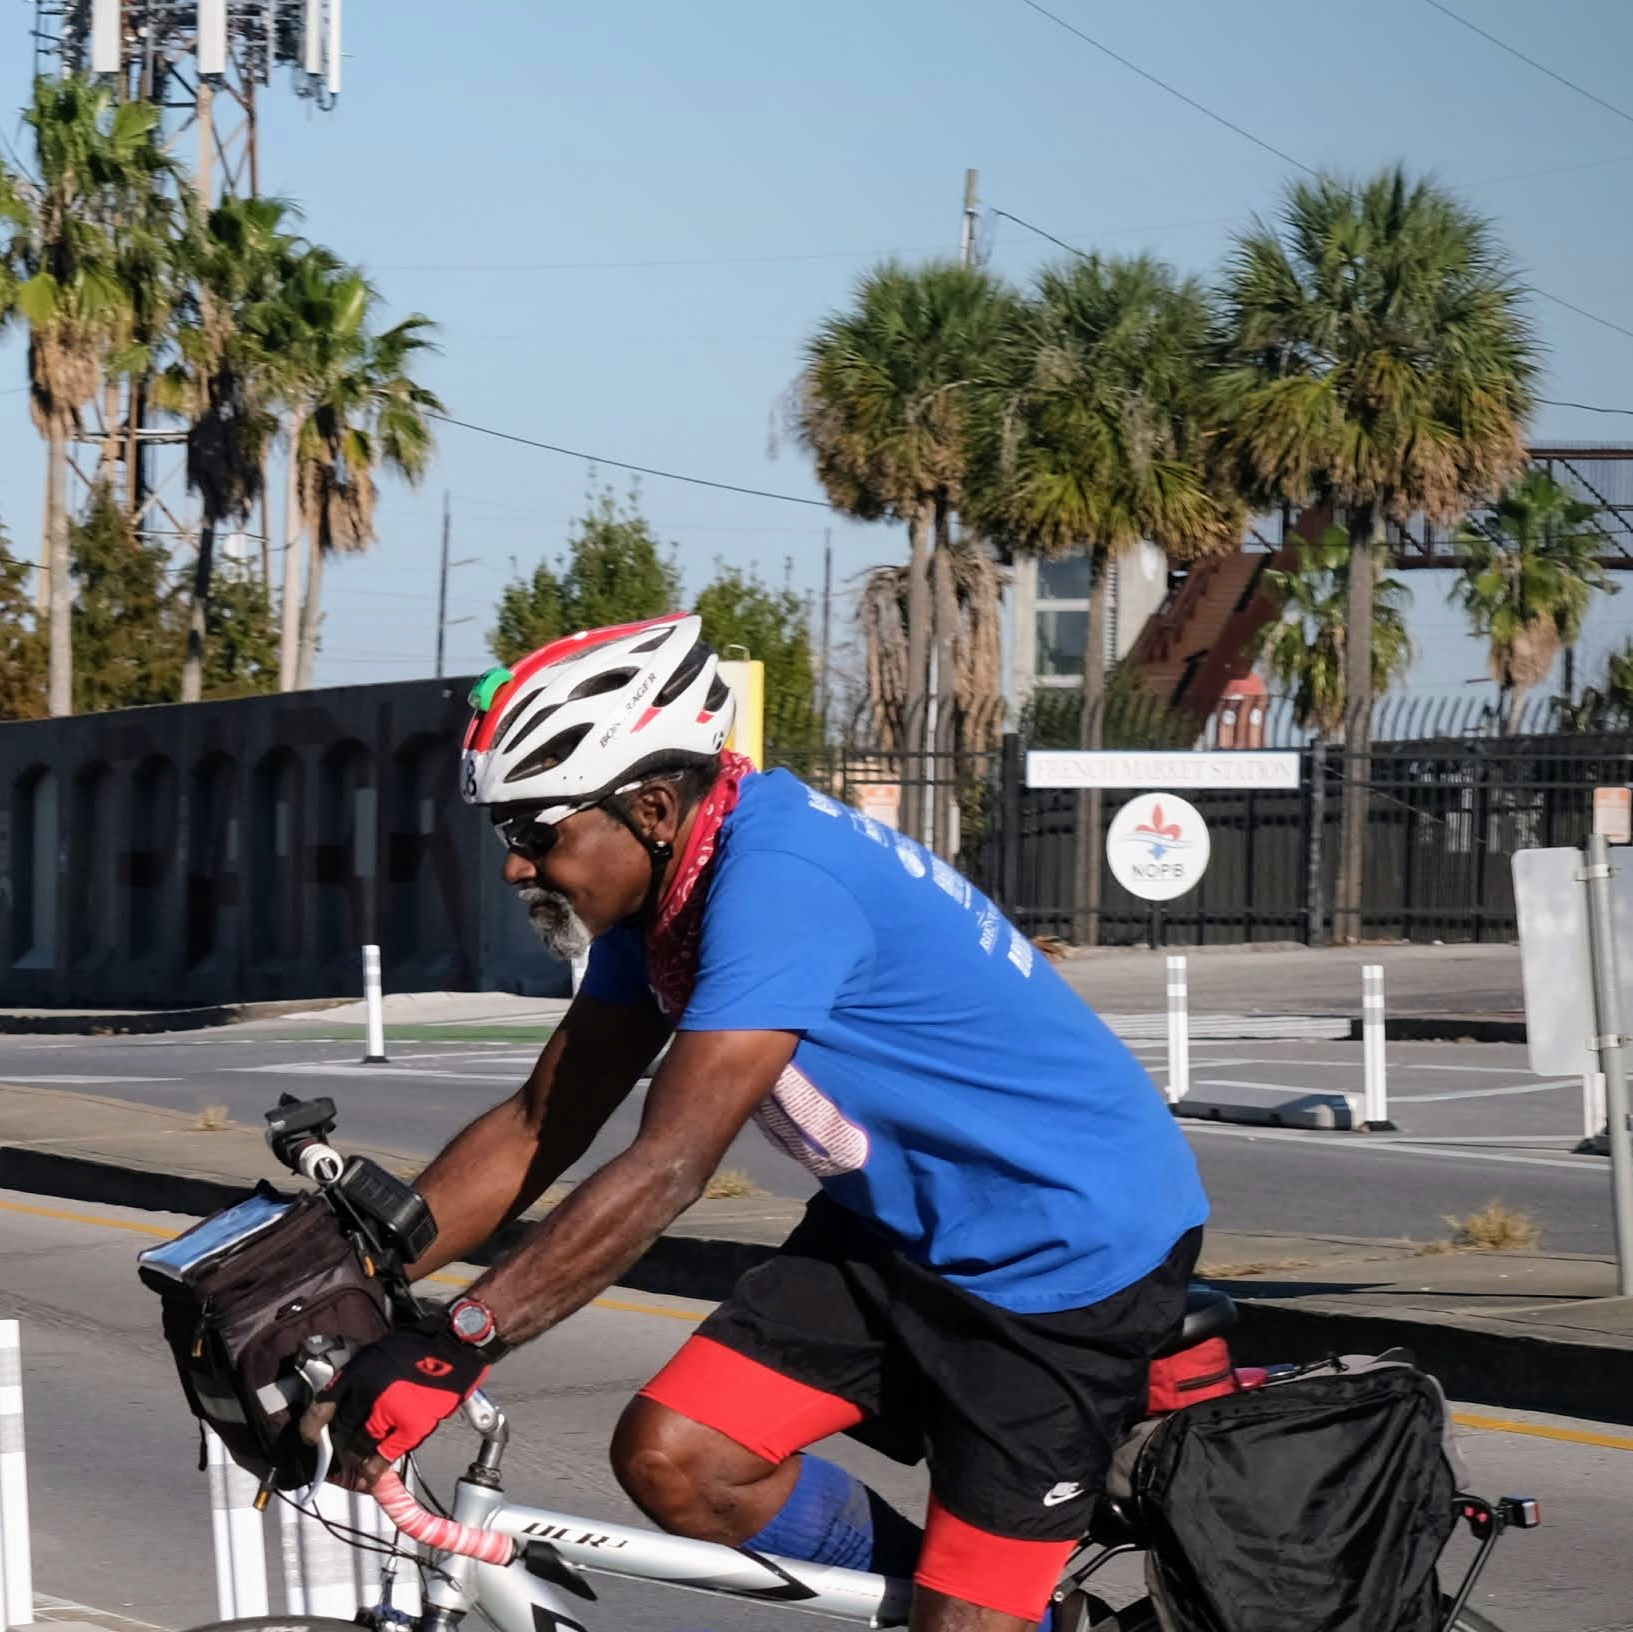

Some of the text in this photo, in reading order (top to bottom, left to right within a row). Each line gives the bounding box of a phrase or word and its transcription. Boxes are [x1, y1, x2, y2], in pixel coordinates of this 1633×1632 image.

[1037, 759, 1291, 780] FRENCH MARKET STATION
[1131, 863, 1184, 878] NOPB
